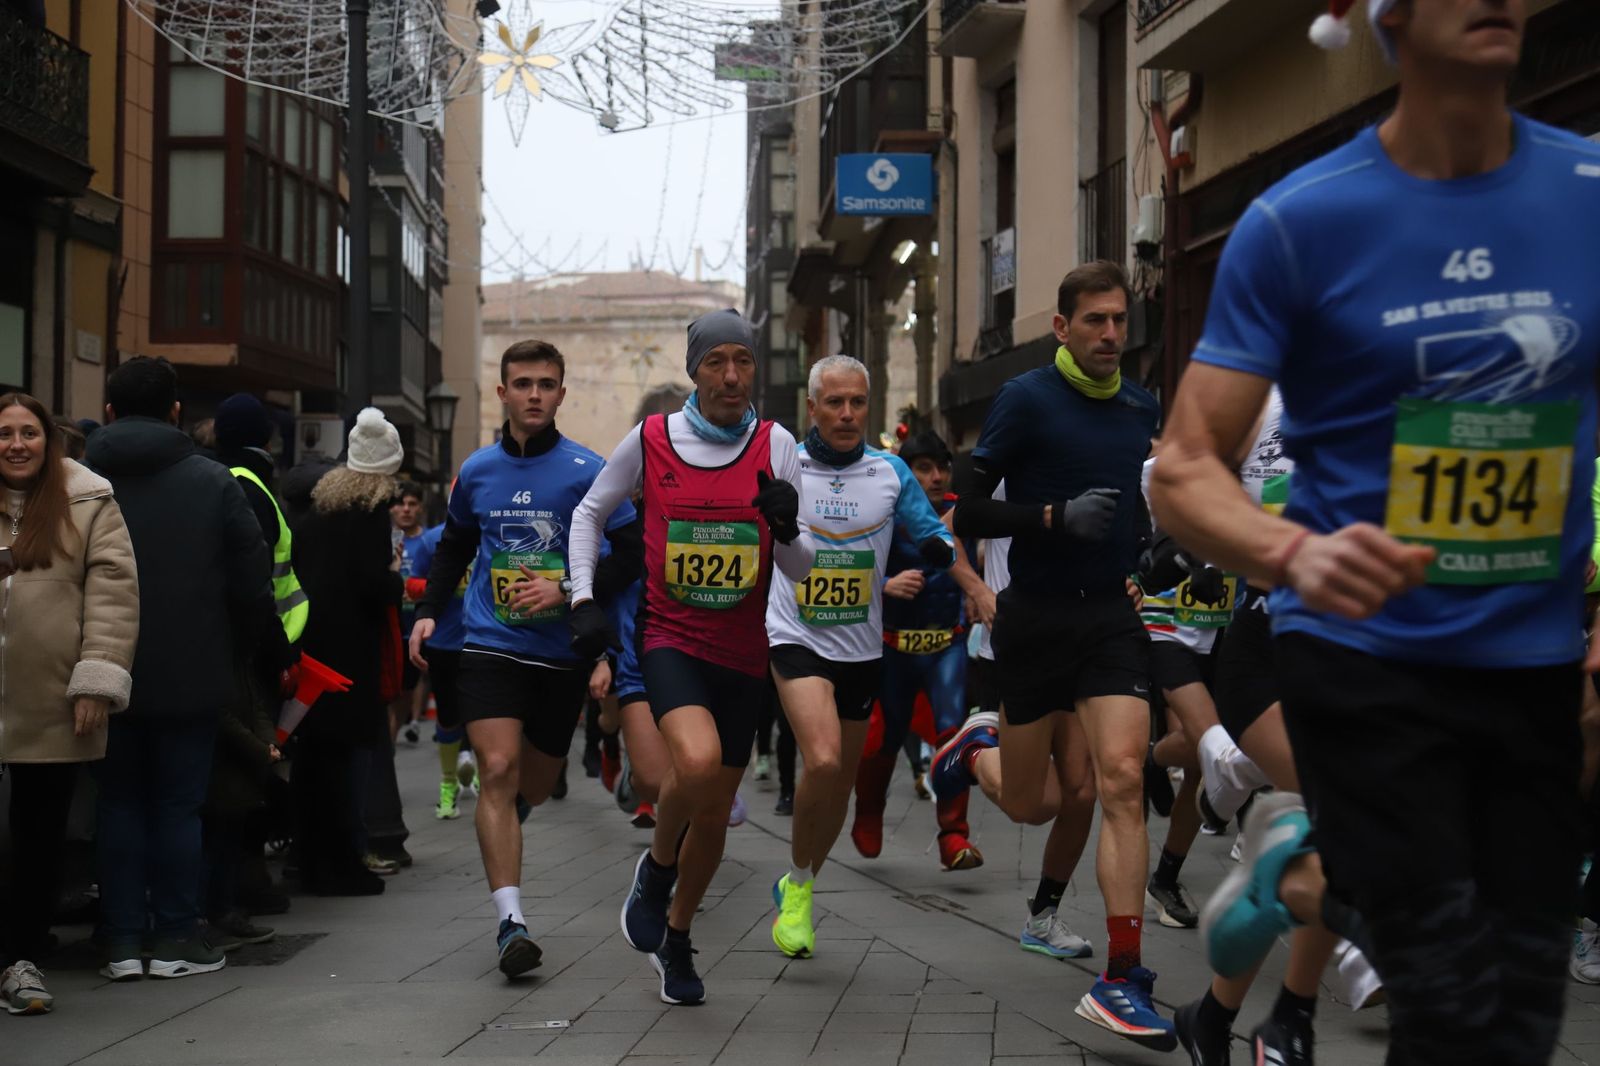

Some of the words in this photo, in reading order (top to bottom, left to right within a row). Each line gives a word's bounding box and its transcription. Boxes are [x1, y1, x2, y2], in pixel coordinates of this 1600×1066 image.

[843, 196, 925, 210] Samsonite
[1441, 247, 1494, 283] 46
[1381, 306, 1418, 327] SAN
[1421, 293, 1509, 320] SILVESTRE
[512, 490, 532, 504] 46
[1412, 455, 1539, 527] 1134
[815, 500, 859, 508] ATLETISMO
[536, 510, 553, 518] 2025
[815, 506, 858, 517] SAMIL
[1438, 553, 1489, 572] CAJA
[672, 552, 743, 588] 1324
[690, 592, 715, 602] CAJA
[716, 592, 746, 603] RURA
[801, 576, 861, 606] 1255
[1181, 582, 1229, 609] 68
[816, 612, 838, 620] CAJA
[839, 610, 865, 620] RURAL
[1194, 614, 1212, 622] CAJA
